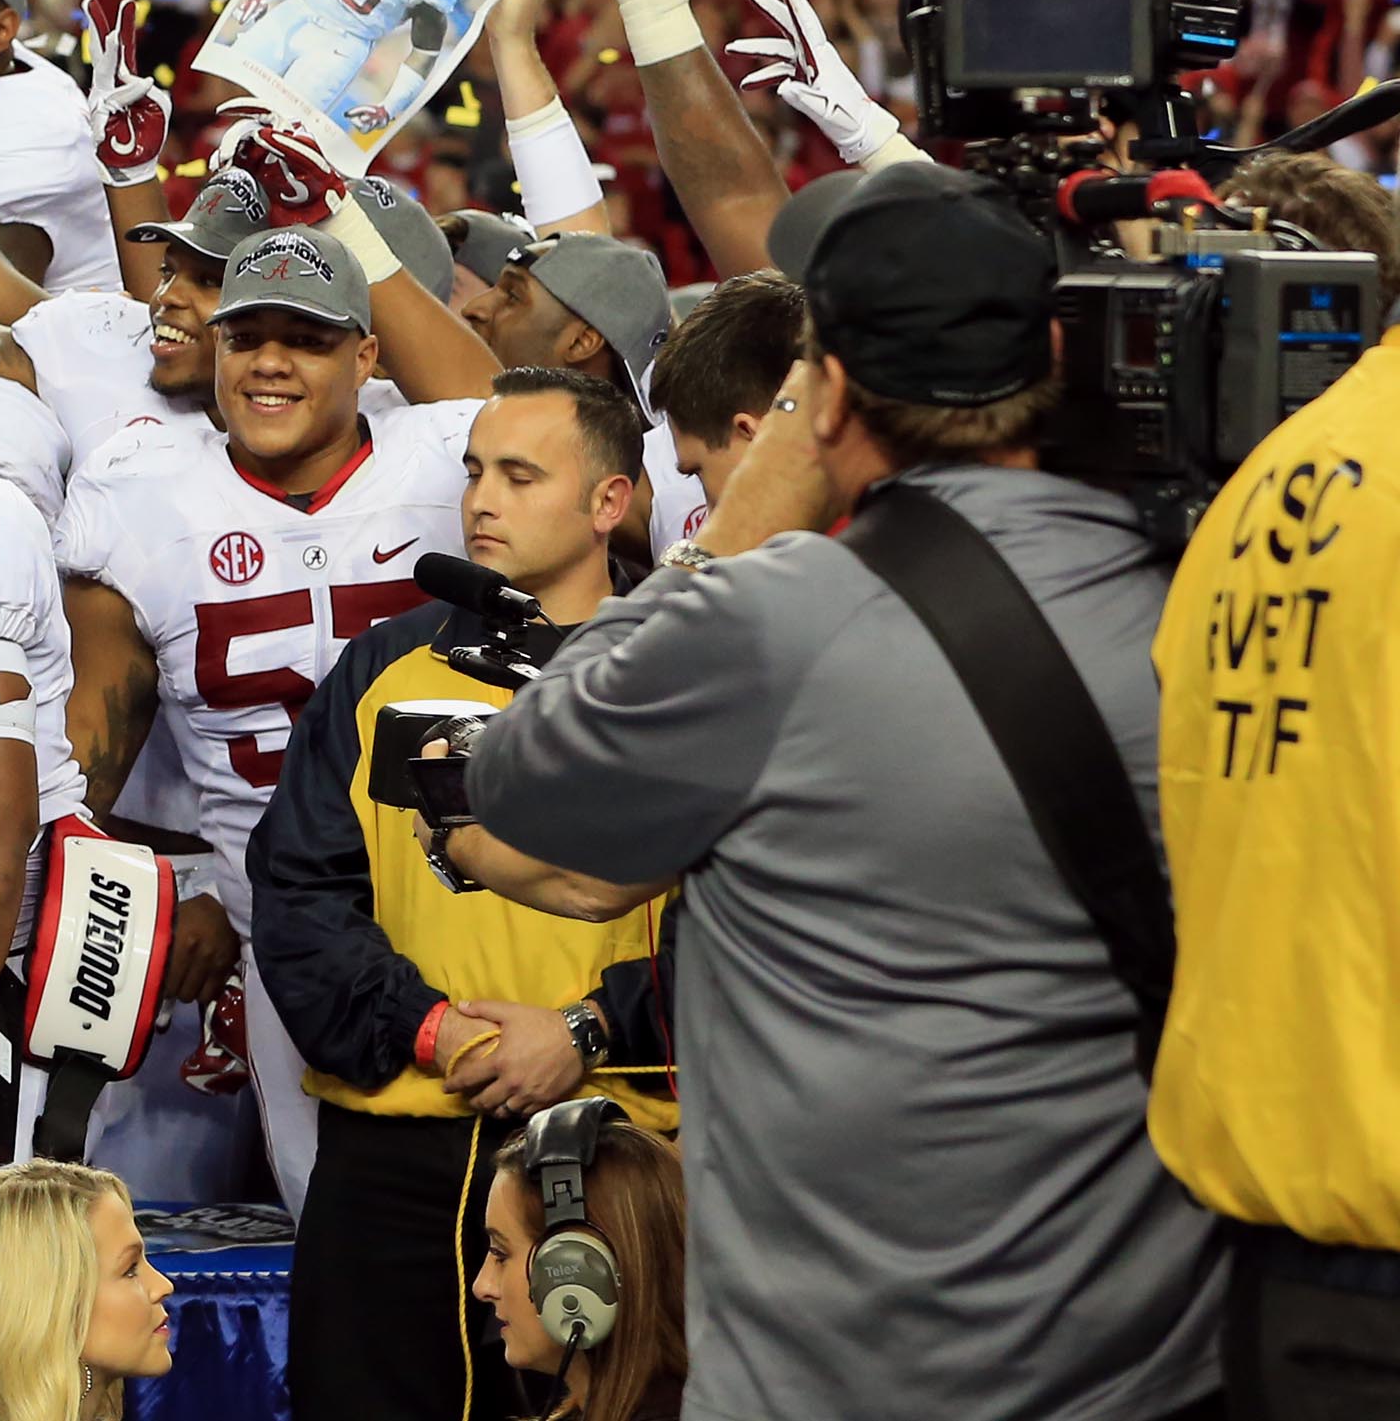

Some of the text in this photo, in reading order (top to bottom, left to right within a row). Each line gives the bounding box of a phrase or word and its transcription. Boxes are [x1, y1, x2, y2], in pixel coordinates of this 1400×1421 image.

[236, 242, 335, 284] CHAMPIONS
[1233, 459, 1362, 564] CSC
[212, 533, 264, 584] SEC
[69, 872, 132, 1021] DOUGLAS
[544, 1264, 580, 1278] Telex
